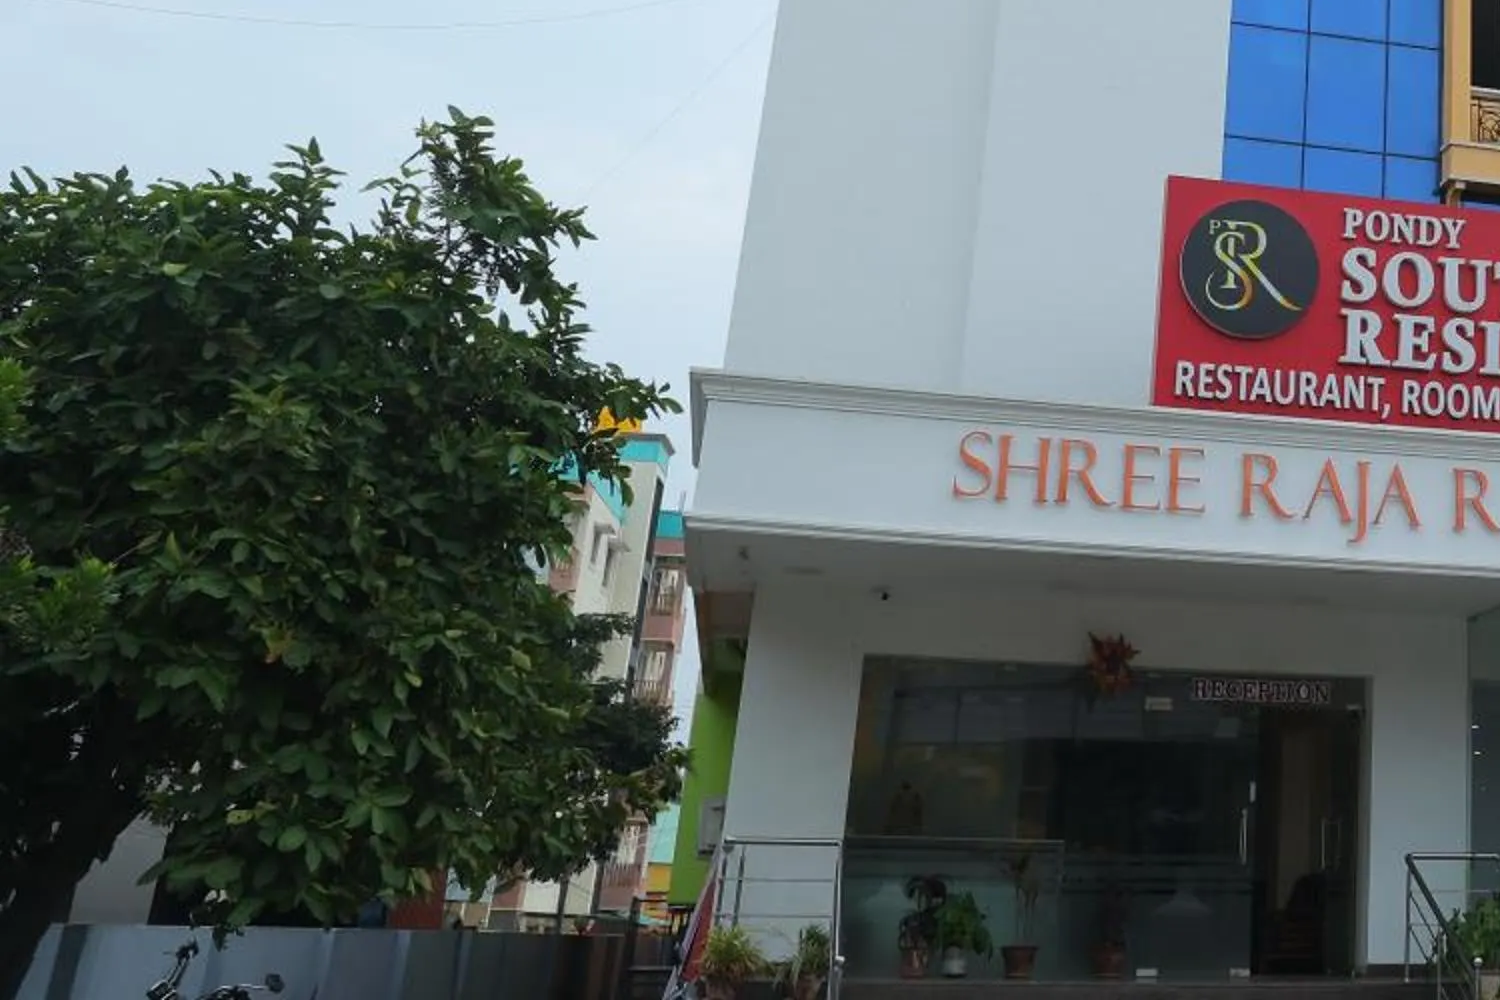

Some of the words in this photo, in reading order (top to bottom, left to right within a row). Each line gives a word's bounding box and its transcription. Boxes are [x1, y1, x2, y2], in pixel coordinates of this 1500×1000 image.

[1342, 207, 1466, 250] PONDY
[1174, 361, 1392, 420] RESTAURANT,
[952, 430, 1206, 515] SHREE
[1238, 452, 1422, 546] RAJA
[1192, 678, 1332, 704] RECEPTION
